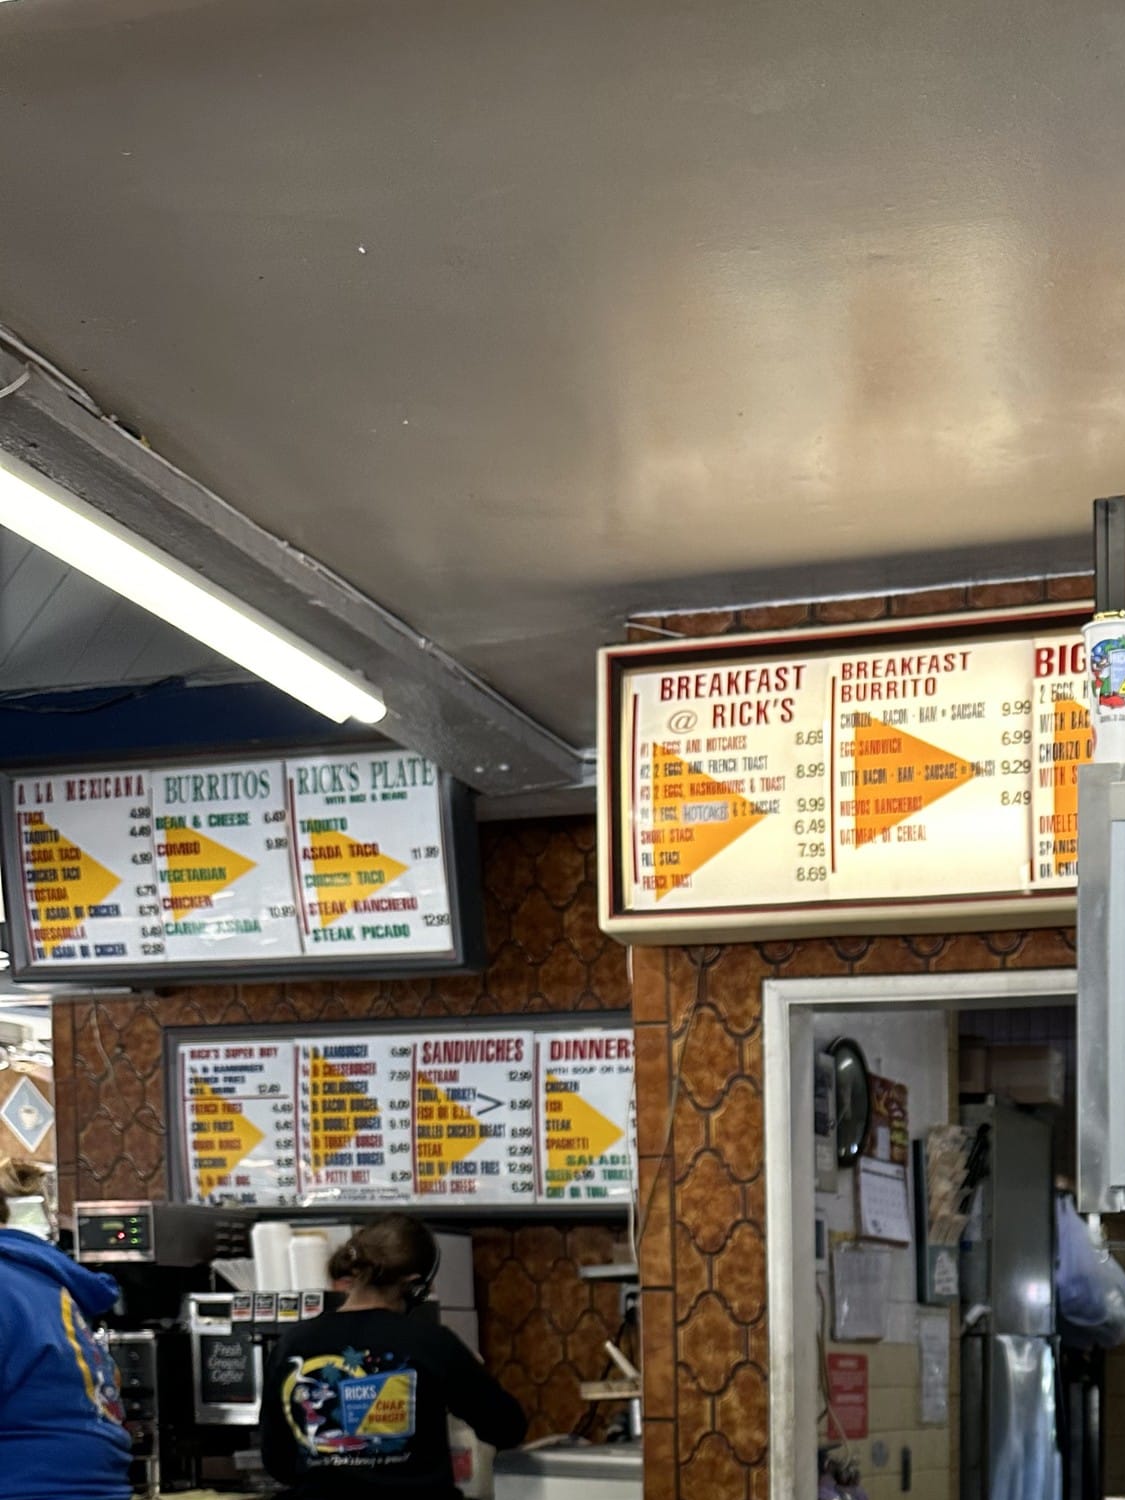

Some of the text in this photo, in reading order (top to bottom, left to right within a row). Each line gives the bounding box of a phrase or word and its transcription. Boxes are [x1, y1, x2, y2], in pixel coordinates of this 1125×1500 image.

[842, 651, 972, 681] BREAKFAST
[660, 665, 807, 701] BREAKFAST
[841, 677, 937, 703] BURRITO
[668, 698, 795, 735] @ RICK'S
[882, 708, 908, 726] BACON
[919, 705, 938, 723] HAM
[951, 702, 986, 721] SAUSAGE
[1002, 700, 1032, 716] 9.99
[1039, 711, 1066, 734] WITH
[663, 730, 824, 755] EGGS AND HOTCAKES 8.69
[840, 730, 1032, 758] EGG SANDWICH 6.99
[1039, 742, 1081, 764] CHORIZO
[296, 757, 435, 795] RICK'S PLATE
[663, 755, 825, 779] EGGS AND FRENCH TOAST 8.99
[863, 768, 887, 785] BACON
[925, 762, 958, 781] SAUSAGE
[1001, 759, 1031, 776] 9.29
[164, 769, 271, 805] BURRITOS
[761, 775, 786, 792] TOAST
[1039, 766, 1066, 789] WITH
[17, 774, 145, 805] A LA MEXICANA
[796, 797, 825, 813] 9.99
[840, 791, 1031, 817] HUEVOS RANCHEROS 8.49
[156, 812, 249, 830] BEAN CHEESE
[300, 817, 347, 834] TAQUITO
[24, 829, 60, 844] TAQUITO
[641, 818, 826, 845] SHORT STACK 6.49
[897, 824, 926, 843] CEREAL
[26, 847, 81, 864] ASADA TACO
[157, 841, 200, 856] COMBO
[302, 842, 380, 860] ASADA TACO
[659, 851, 680, 866] STACK
[798, 842, 826, 858] 7.99
[62, 867, 81, 880] TACO
[159, 867, 227, 883] VEGETARIAN
[358, 869, 385, 885] TACO
[642, 866, 826, 891] FRENCH TOAST 8.69
[30, 887, 69, 902] TOSTADA
[163, 895, 213, 911] CHICKEN
[309, 900, 348, 916] STEAK
[353, 896, 418, 914] RANCHERO
[312, 923, 411, 943] STEAK PICADO
[422, 1038, 524, 1064] SANDWICHES
[417, 1070, 459, 1084] PASTRAMI
[545, 1080, 580, 1093] CHICKEN
[446, 1088, 477, 1101] TURKEY
[417, 1105, 434, 1119] FISH
[545, 1119, 571, 1131] STEAK
[418, 1143, 443, 1157] STEAK
[545, 1137, 589, 1149] SPAGHETTI
[452, 1161, 477, 1174] FRENCH
[345, 1385, 377, 1400] RICKS
